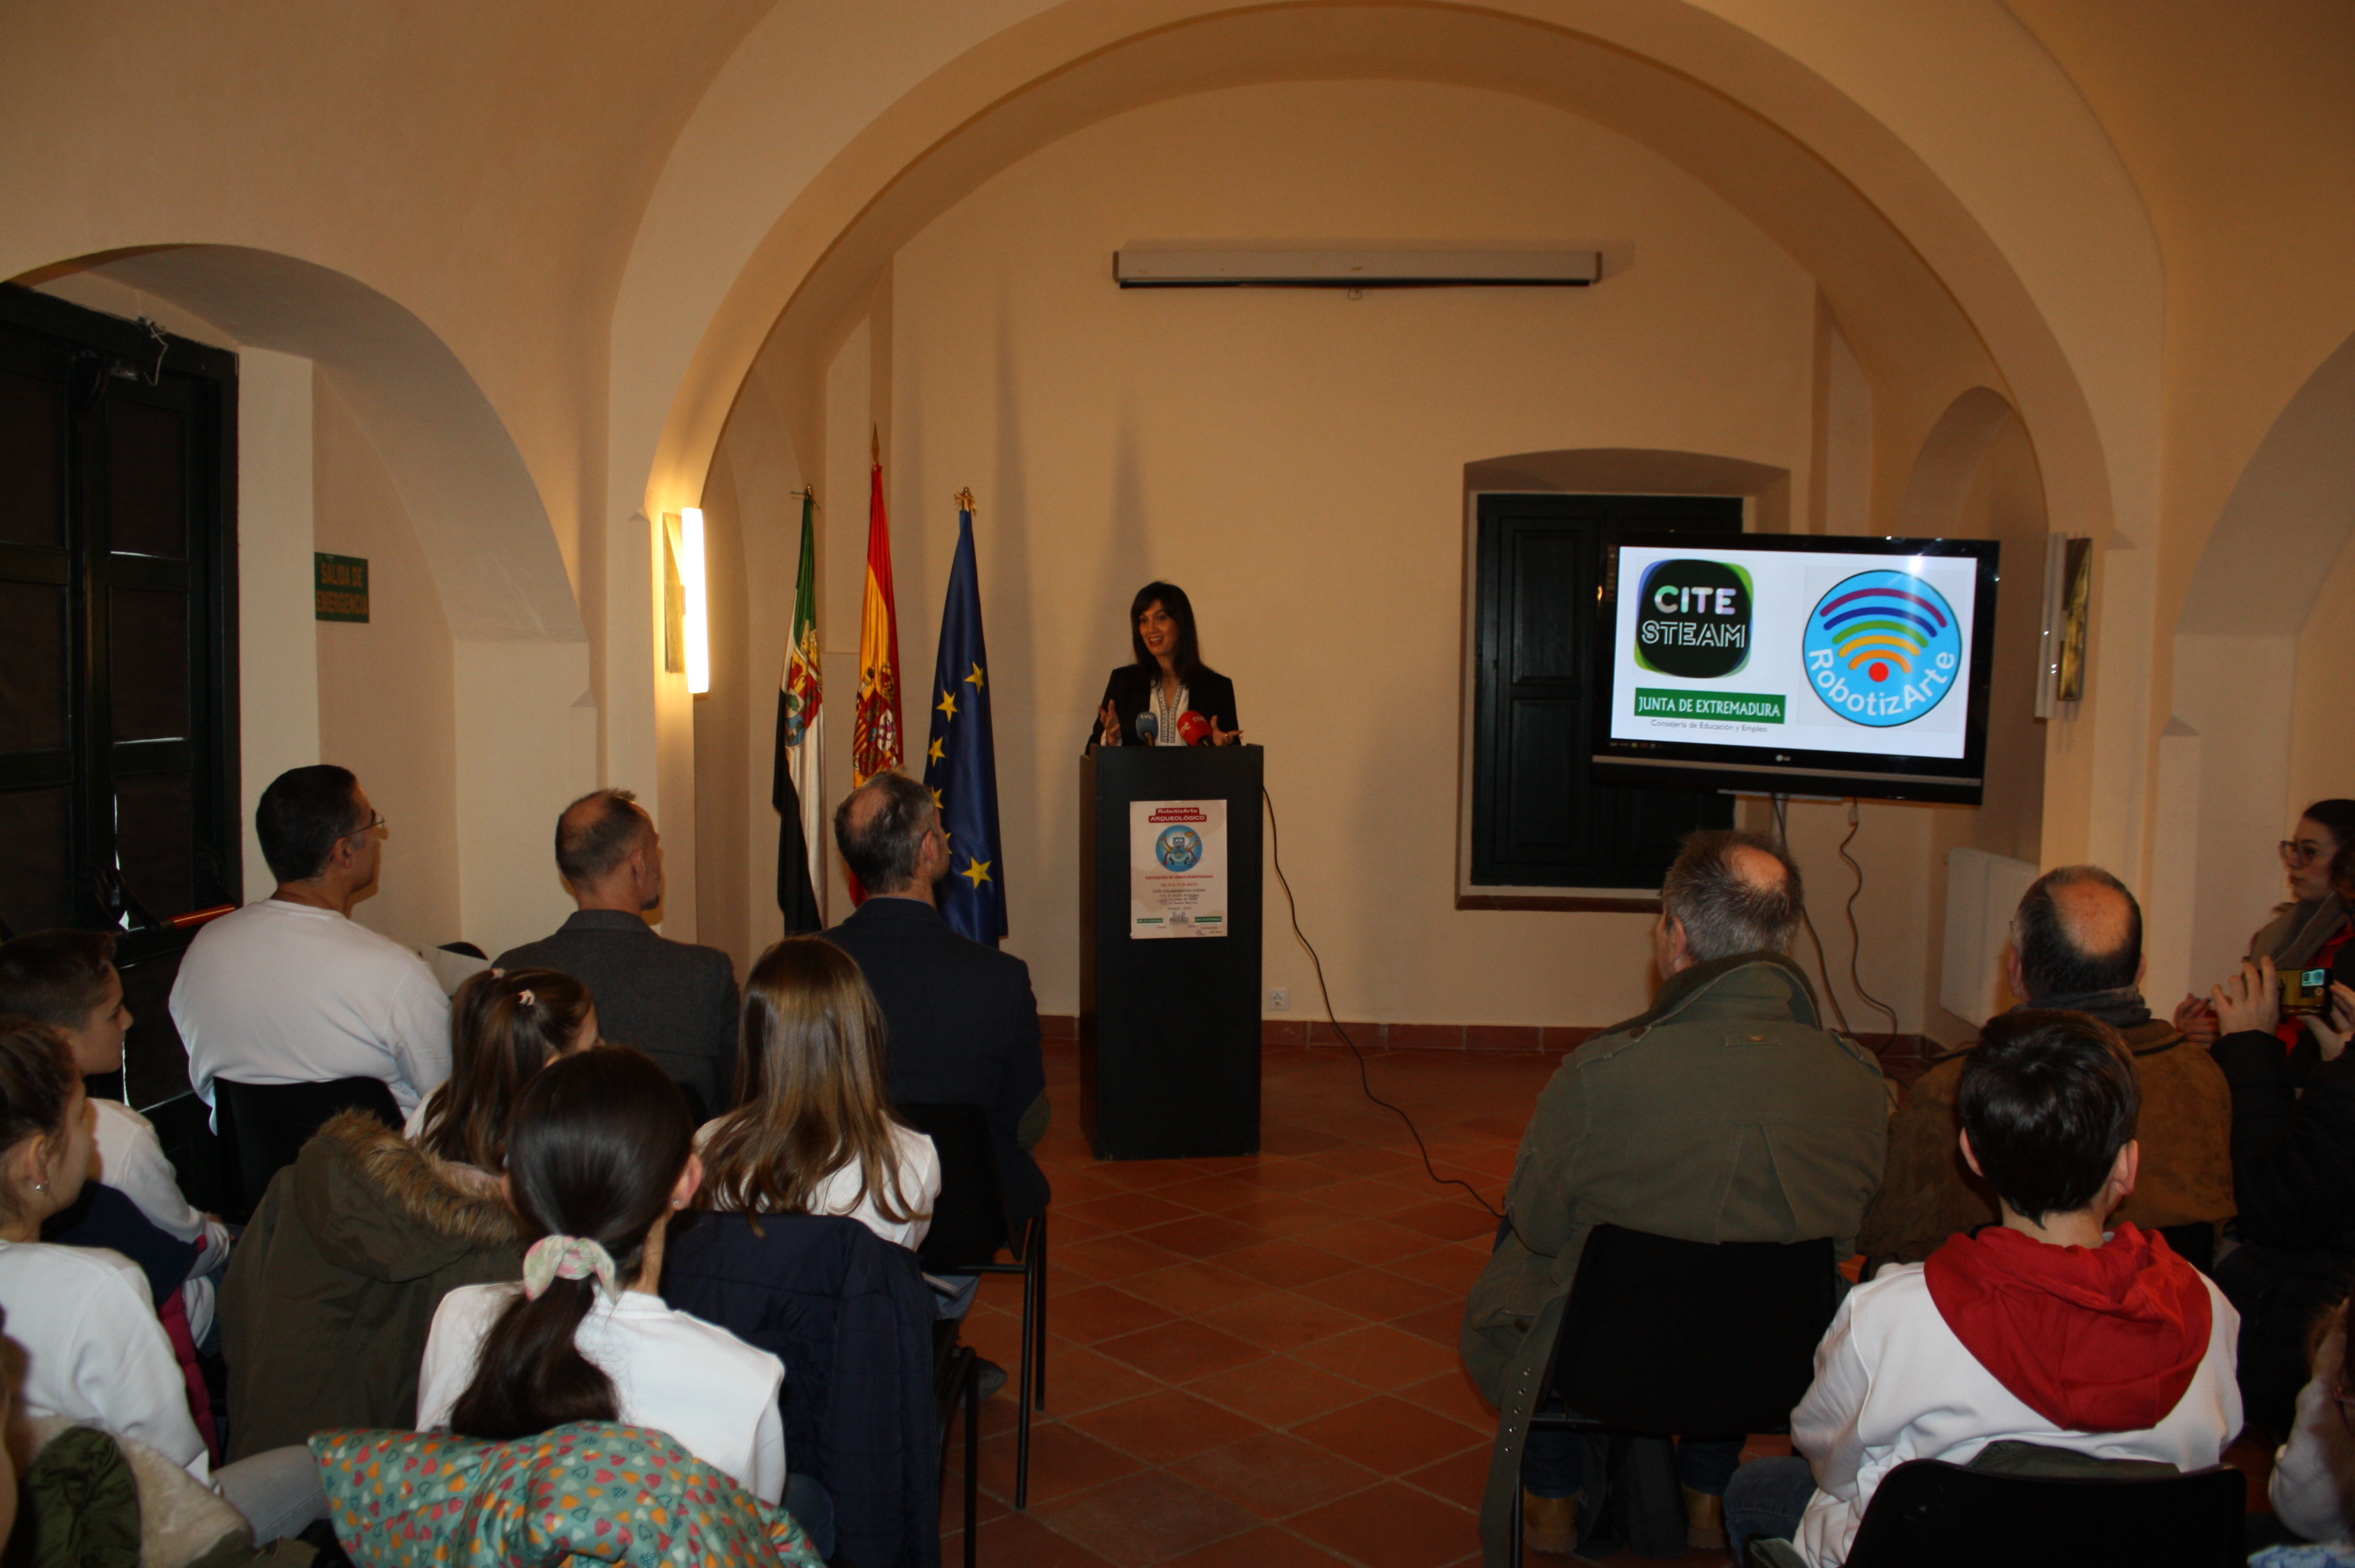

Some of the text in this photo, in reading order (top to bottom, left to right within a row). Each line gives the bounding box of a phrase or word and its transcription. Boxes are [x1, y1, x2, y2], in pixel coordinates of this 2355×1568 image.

[321, 563, 362, 587] SALIDA DE
[316, 590, 368, 614] EMERGENCIA
[1654, 585, 1737, 615] CITE
[1641, 620, 1746, 648] STEAM
[1808, 648, 1955, 716] RobotizArte
[1638, 696, 1782, 718] JUNTA DE EXTREMADURA
[1650, 719, 1688, 729] Consejería
[1700, 721, 1734, 731] Educación
[1741, 724, 1769, 733] Empleo
